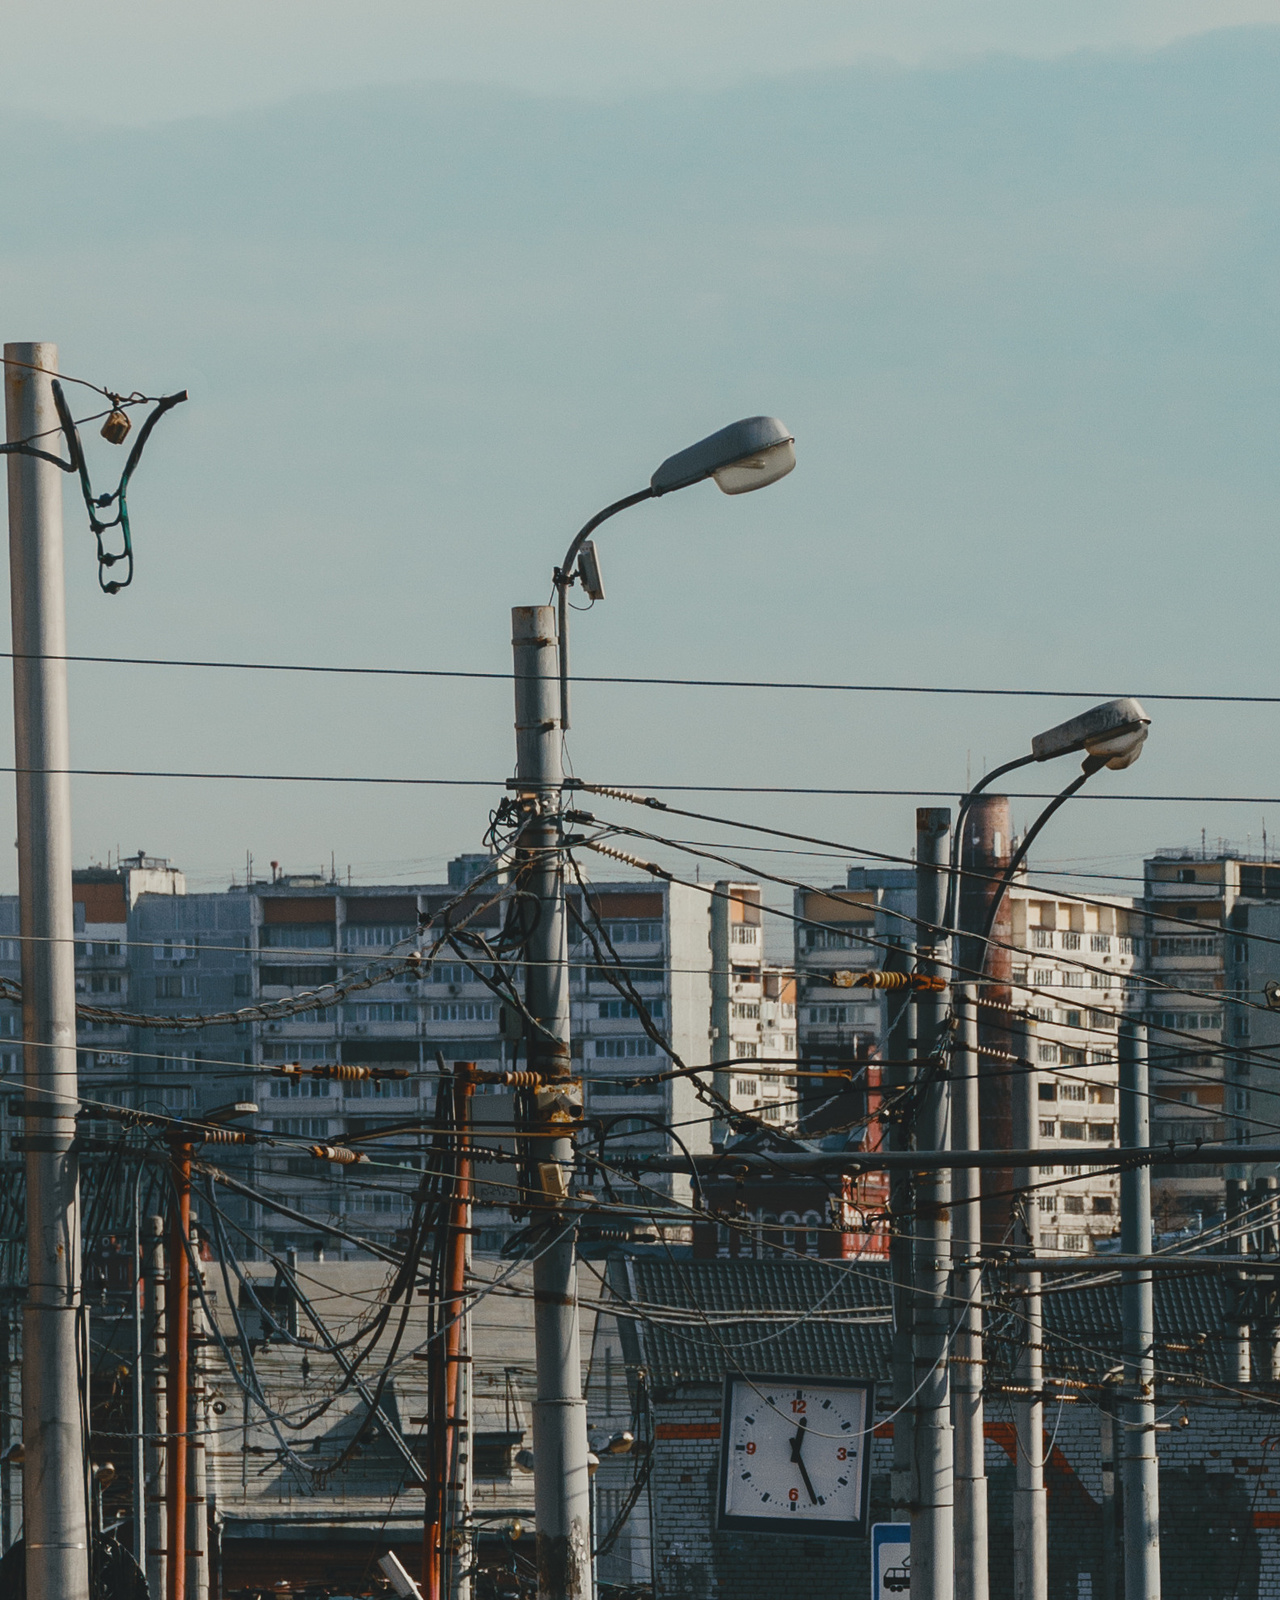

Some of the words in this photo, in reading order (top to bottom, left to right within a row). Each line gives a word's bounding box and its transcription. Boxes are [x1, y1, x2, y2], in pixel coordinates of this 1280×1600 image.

[790, 1399, 807, 1413] 12
[745, 1442, 757, 1455] 9
[836, 1447, 847, 1461] 3
[788, 1487, 799, 1501] 6
